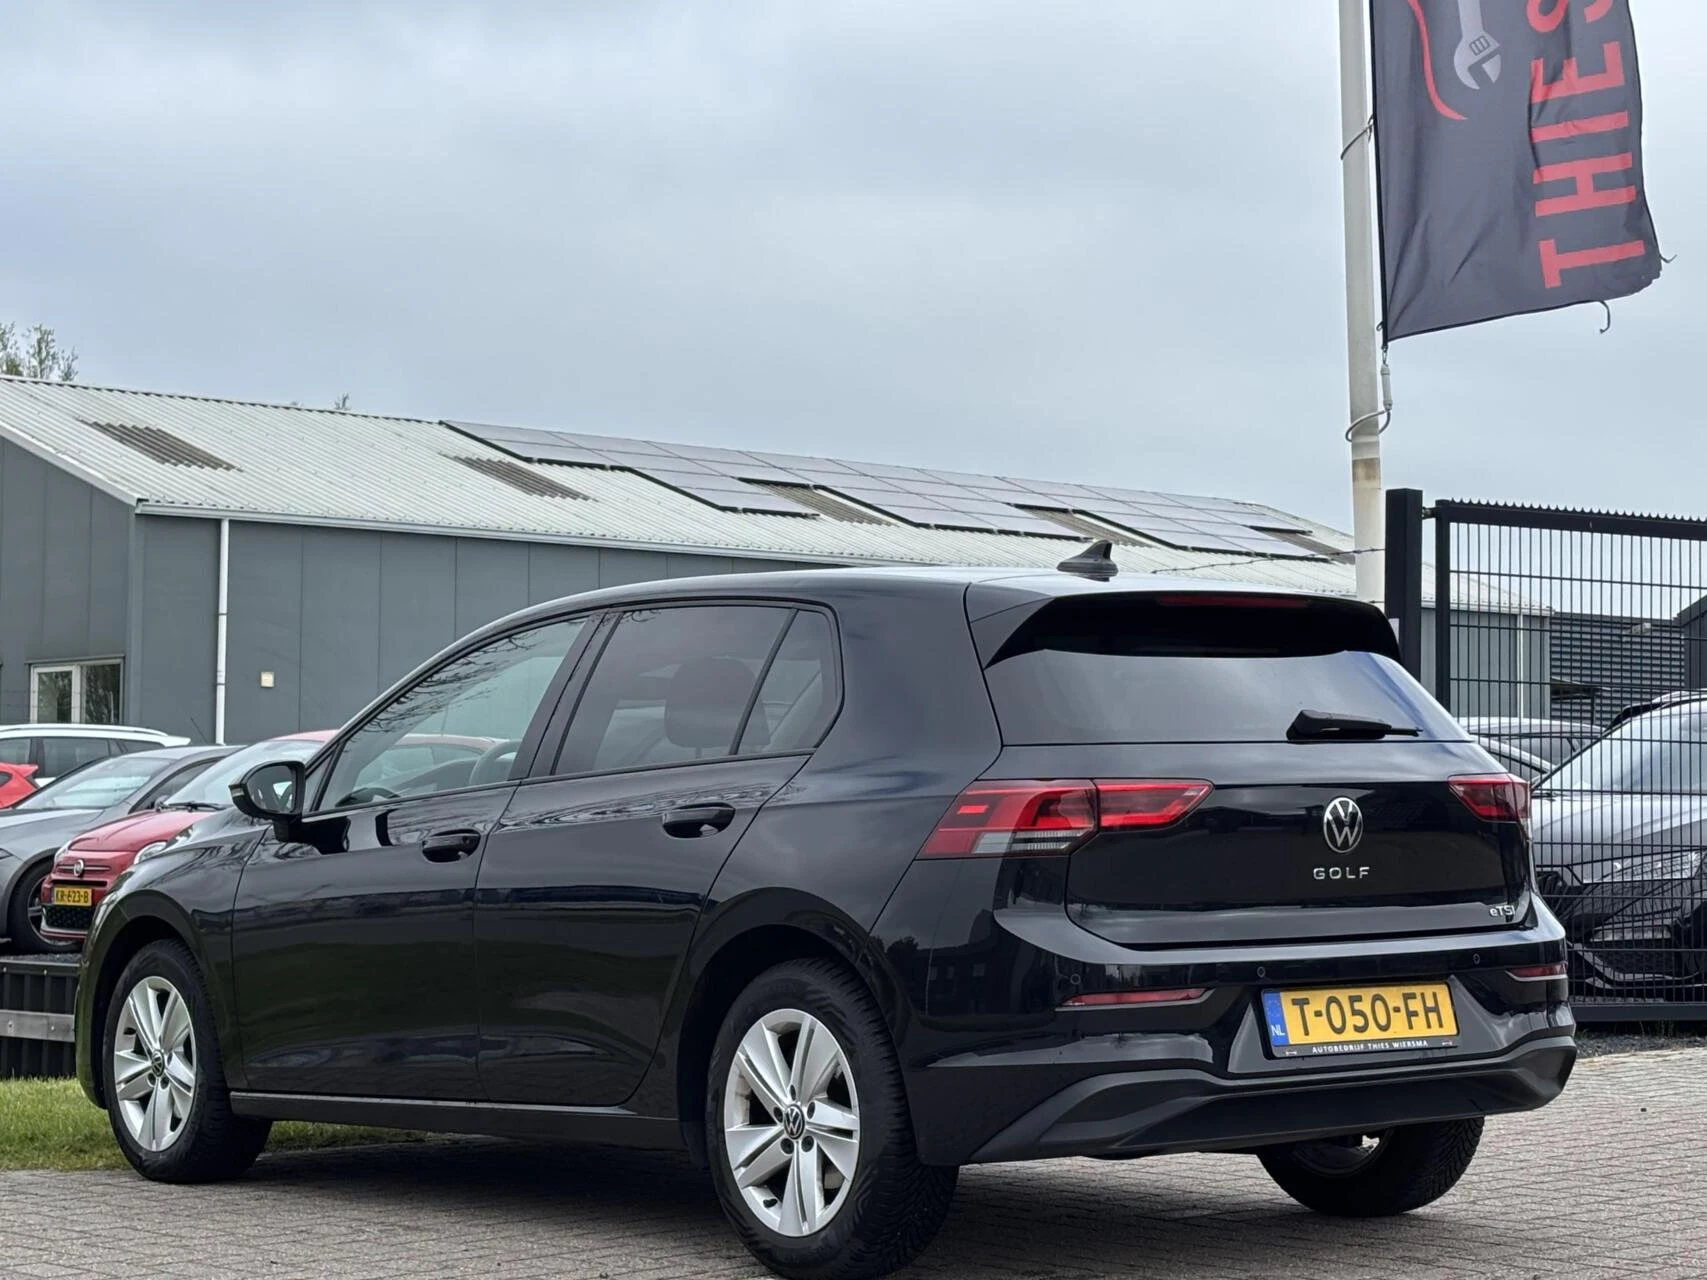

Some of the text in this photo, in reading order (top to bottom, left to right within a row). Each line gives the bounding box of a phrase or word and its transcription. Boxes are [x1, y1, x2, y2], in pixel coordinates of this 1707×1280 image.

[1313, 866, 1370, 880] GOLF
[1489, 904, 1516, 917] eTSI
[1291, 991, 1444, 1036] T-050-FH
[1270, 1024, 1286, 1036] NL
[1312, 1040, 1429, 1054] AUTOBEDRIJF THIES WIERSMA
